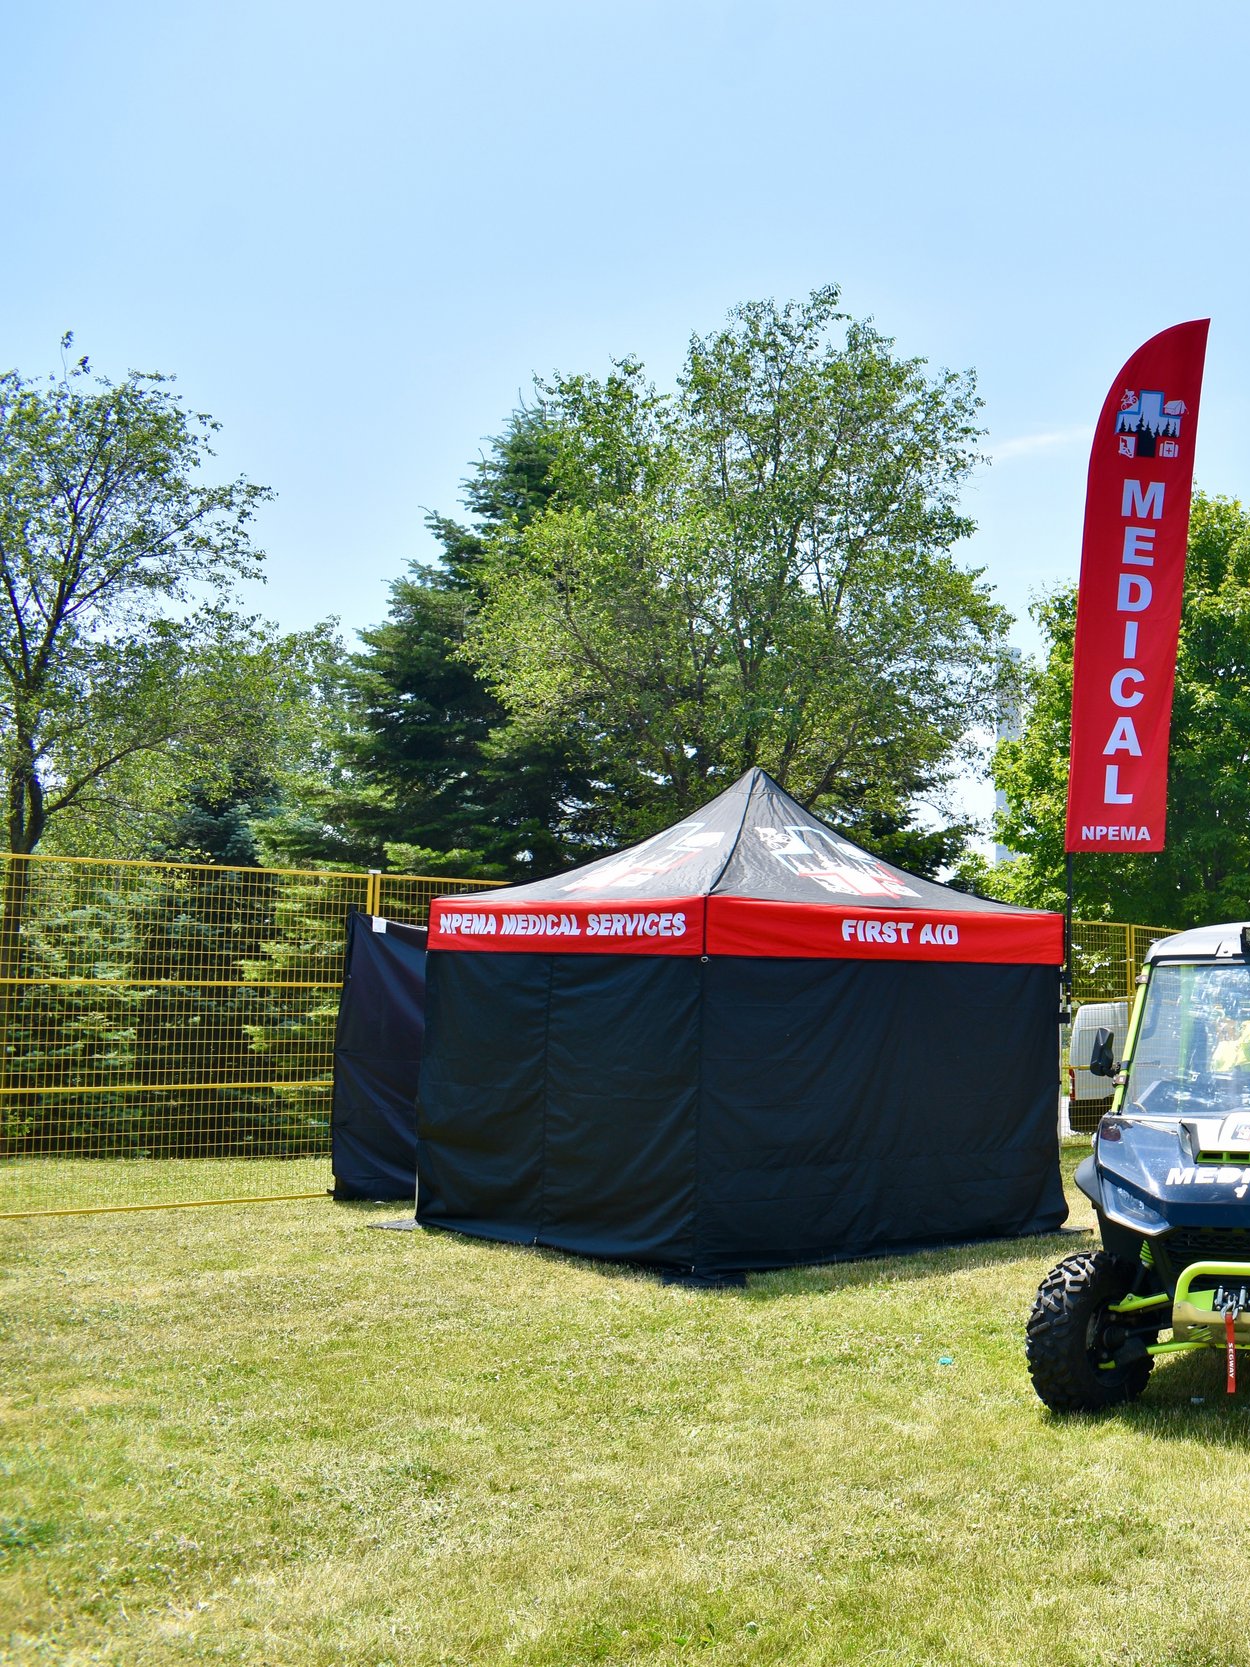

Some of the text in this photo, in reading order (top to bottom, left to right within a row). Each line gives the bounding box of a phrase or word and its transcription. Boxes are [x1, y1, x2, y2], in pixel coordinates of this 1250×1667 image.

[1102, 479, 1165, 805] MEDICAL
[1081, 826, 1151, 841] NPEMA
[439, 912, 687, 937] NPEMA MEDICAL SERVICES
[842, 919, 959, 945] FIRST AID
